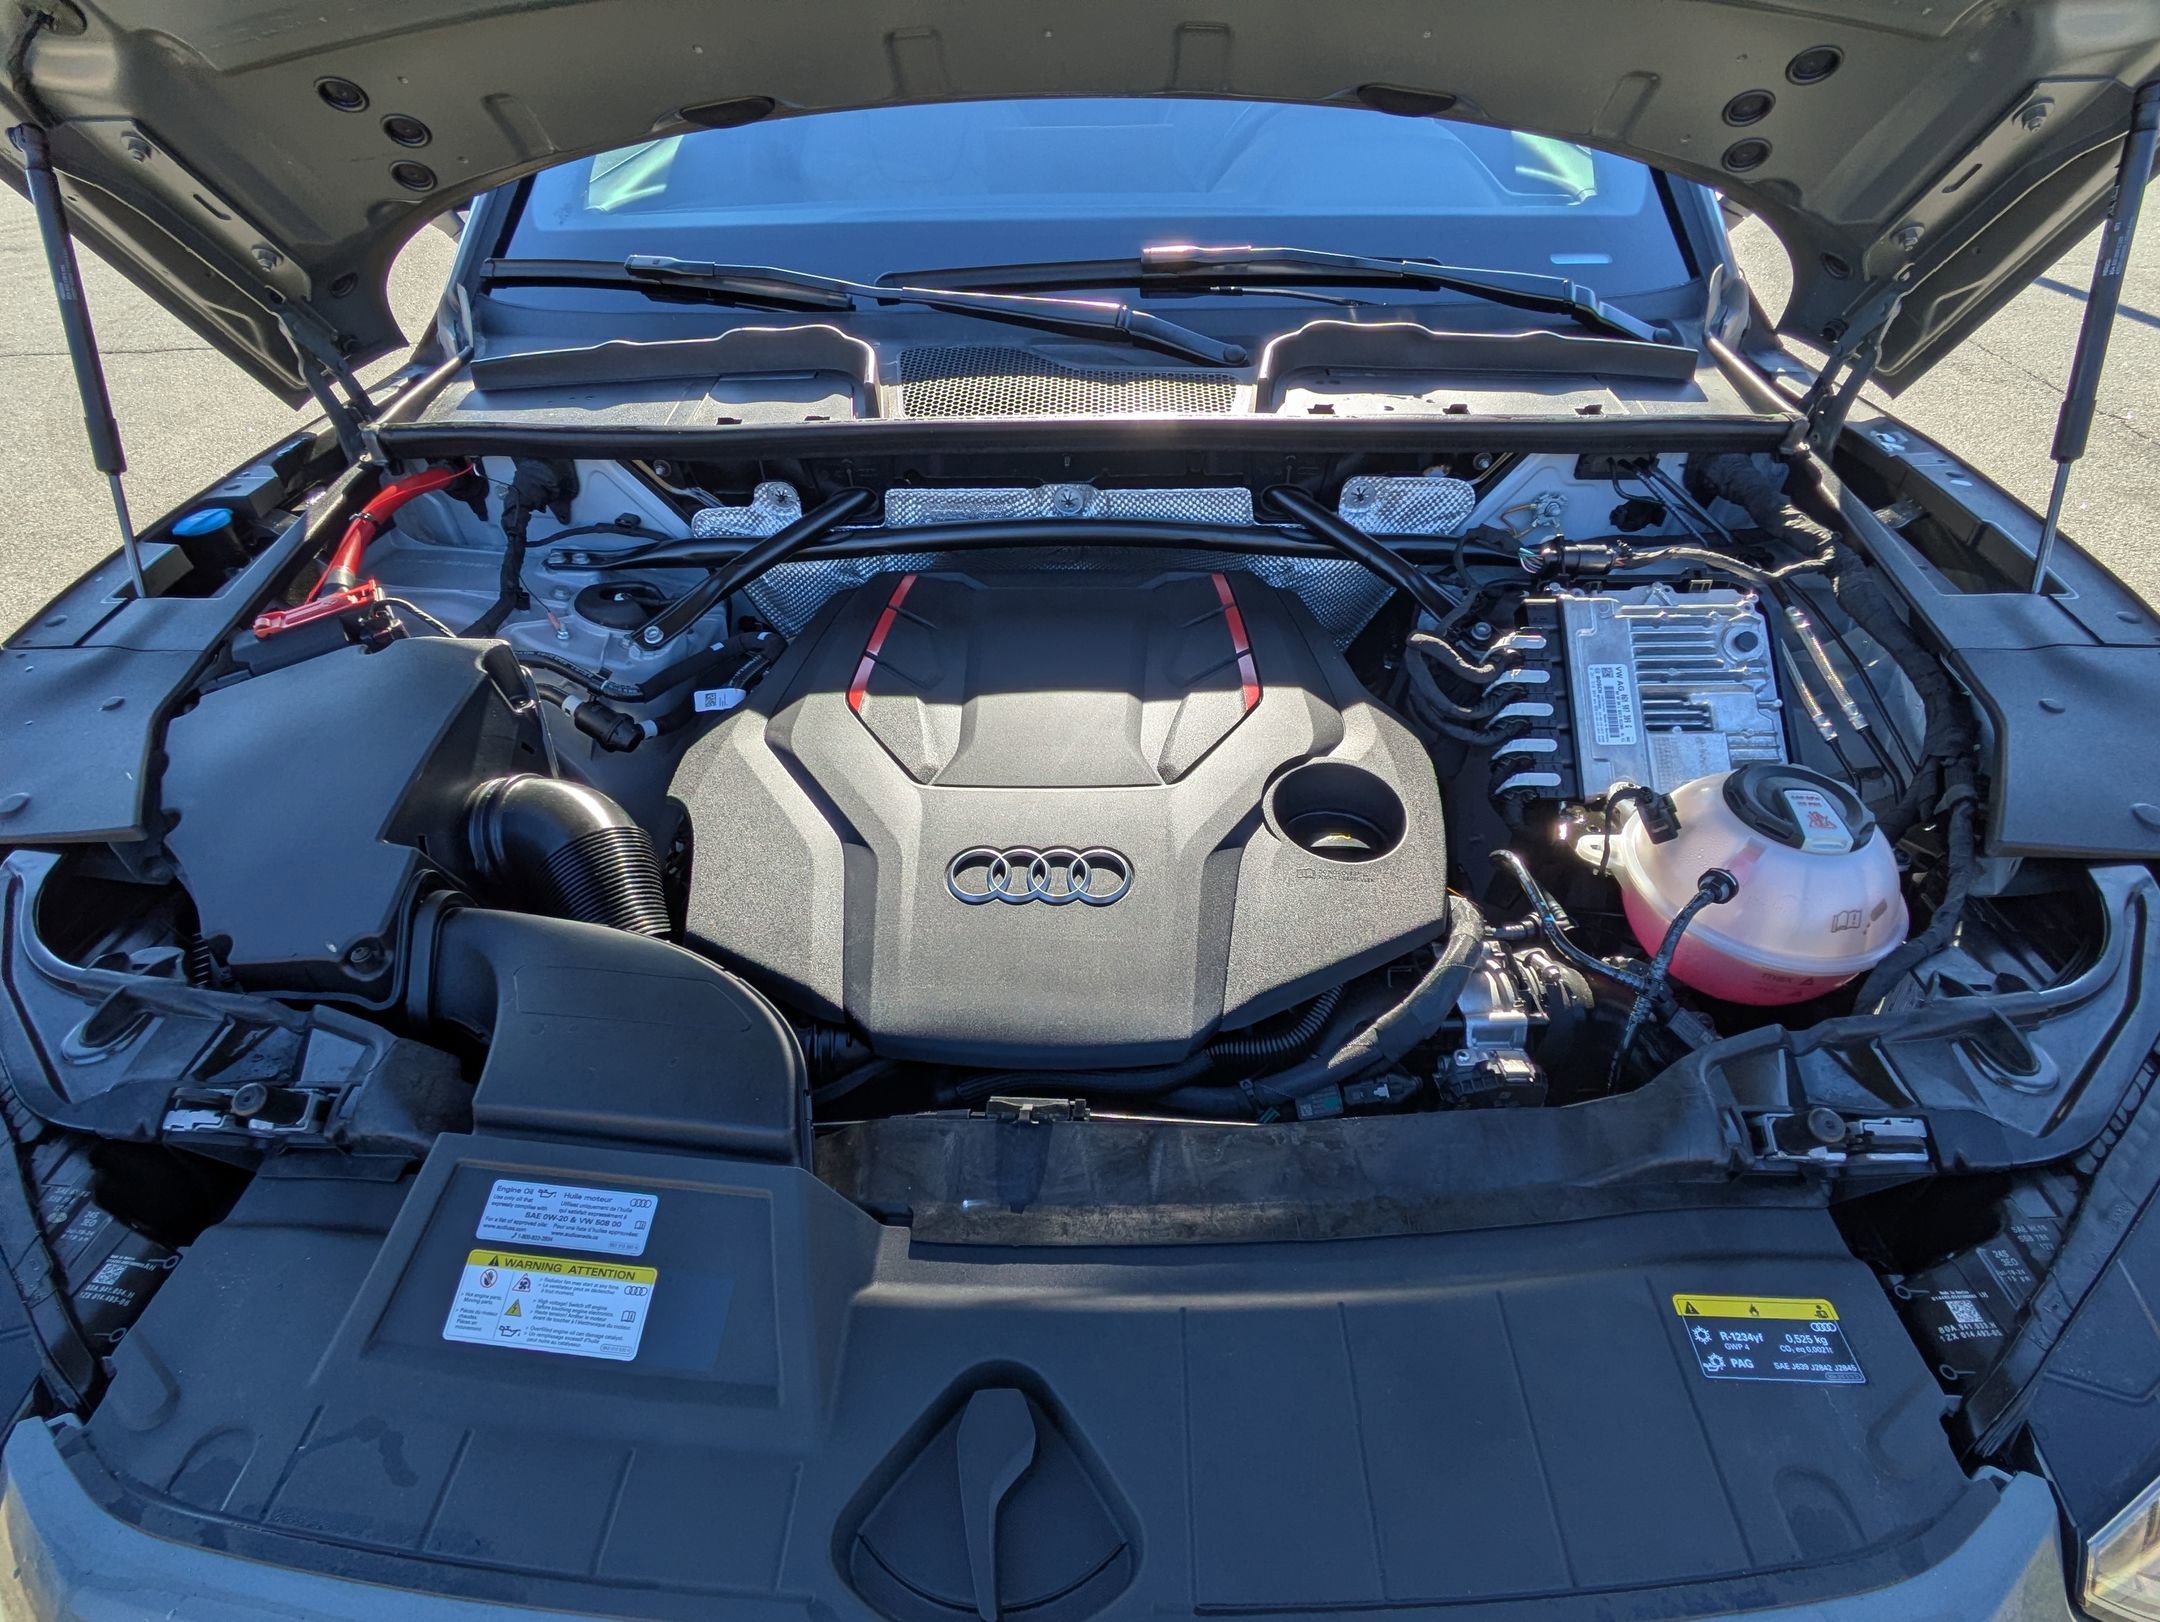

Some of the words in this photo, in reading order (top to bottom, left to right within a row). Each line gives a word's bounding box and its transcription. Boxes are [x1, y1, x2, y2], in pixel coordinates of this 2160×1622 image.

[1615, 666, 1623, 679] VW
[1616, 681, 1625, 691] AG
[496, 1185, 522, 1194] Engine
[542, 1213, 569, 1222] 0W-20
[505, 1258, 562, 1272] WARNING
[568, 1265, 636, 1280] ATTENTION
[1719, 1331, 1764, 1343] R-1234yf
[1785, 1334, 1813, 1344] 0,525
[1814, 1335, 1829, 1346] kg
[1730, 1358, 1755, 1369] PAG
[1773, 1362, 1791, 1370] SAE
